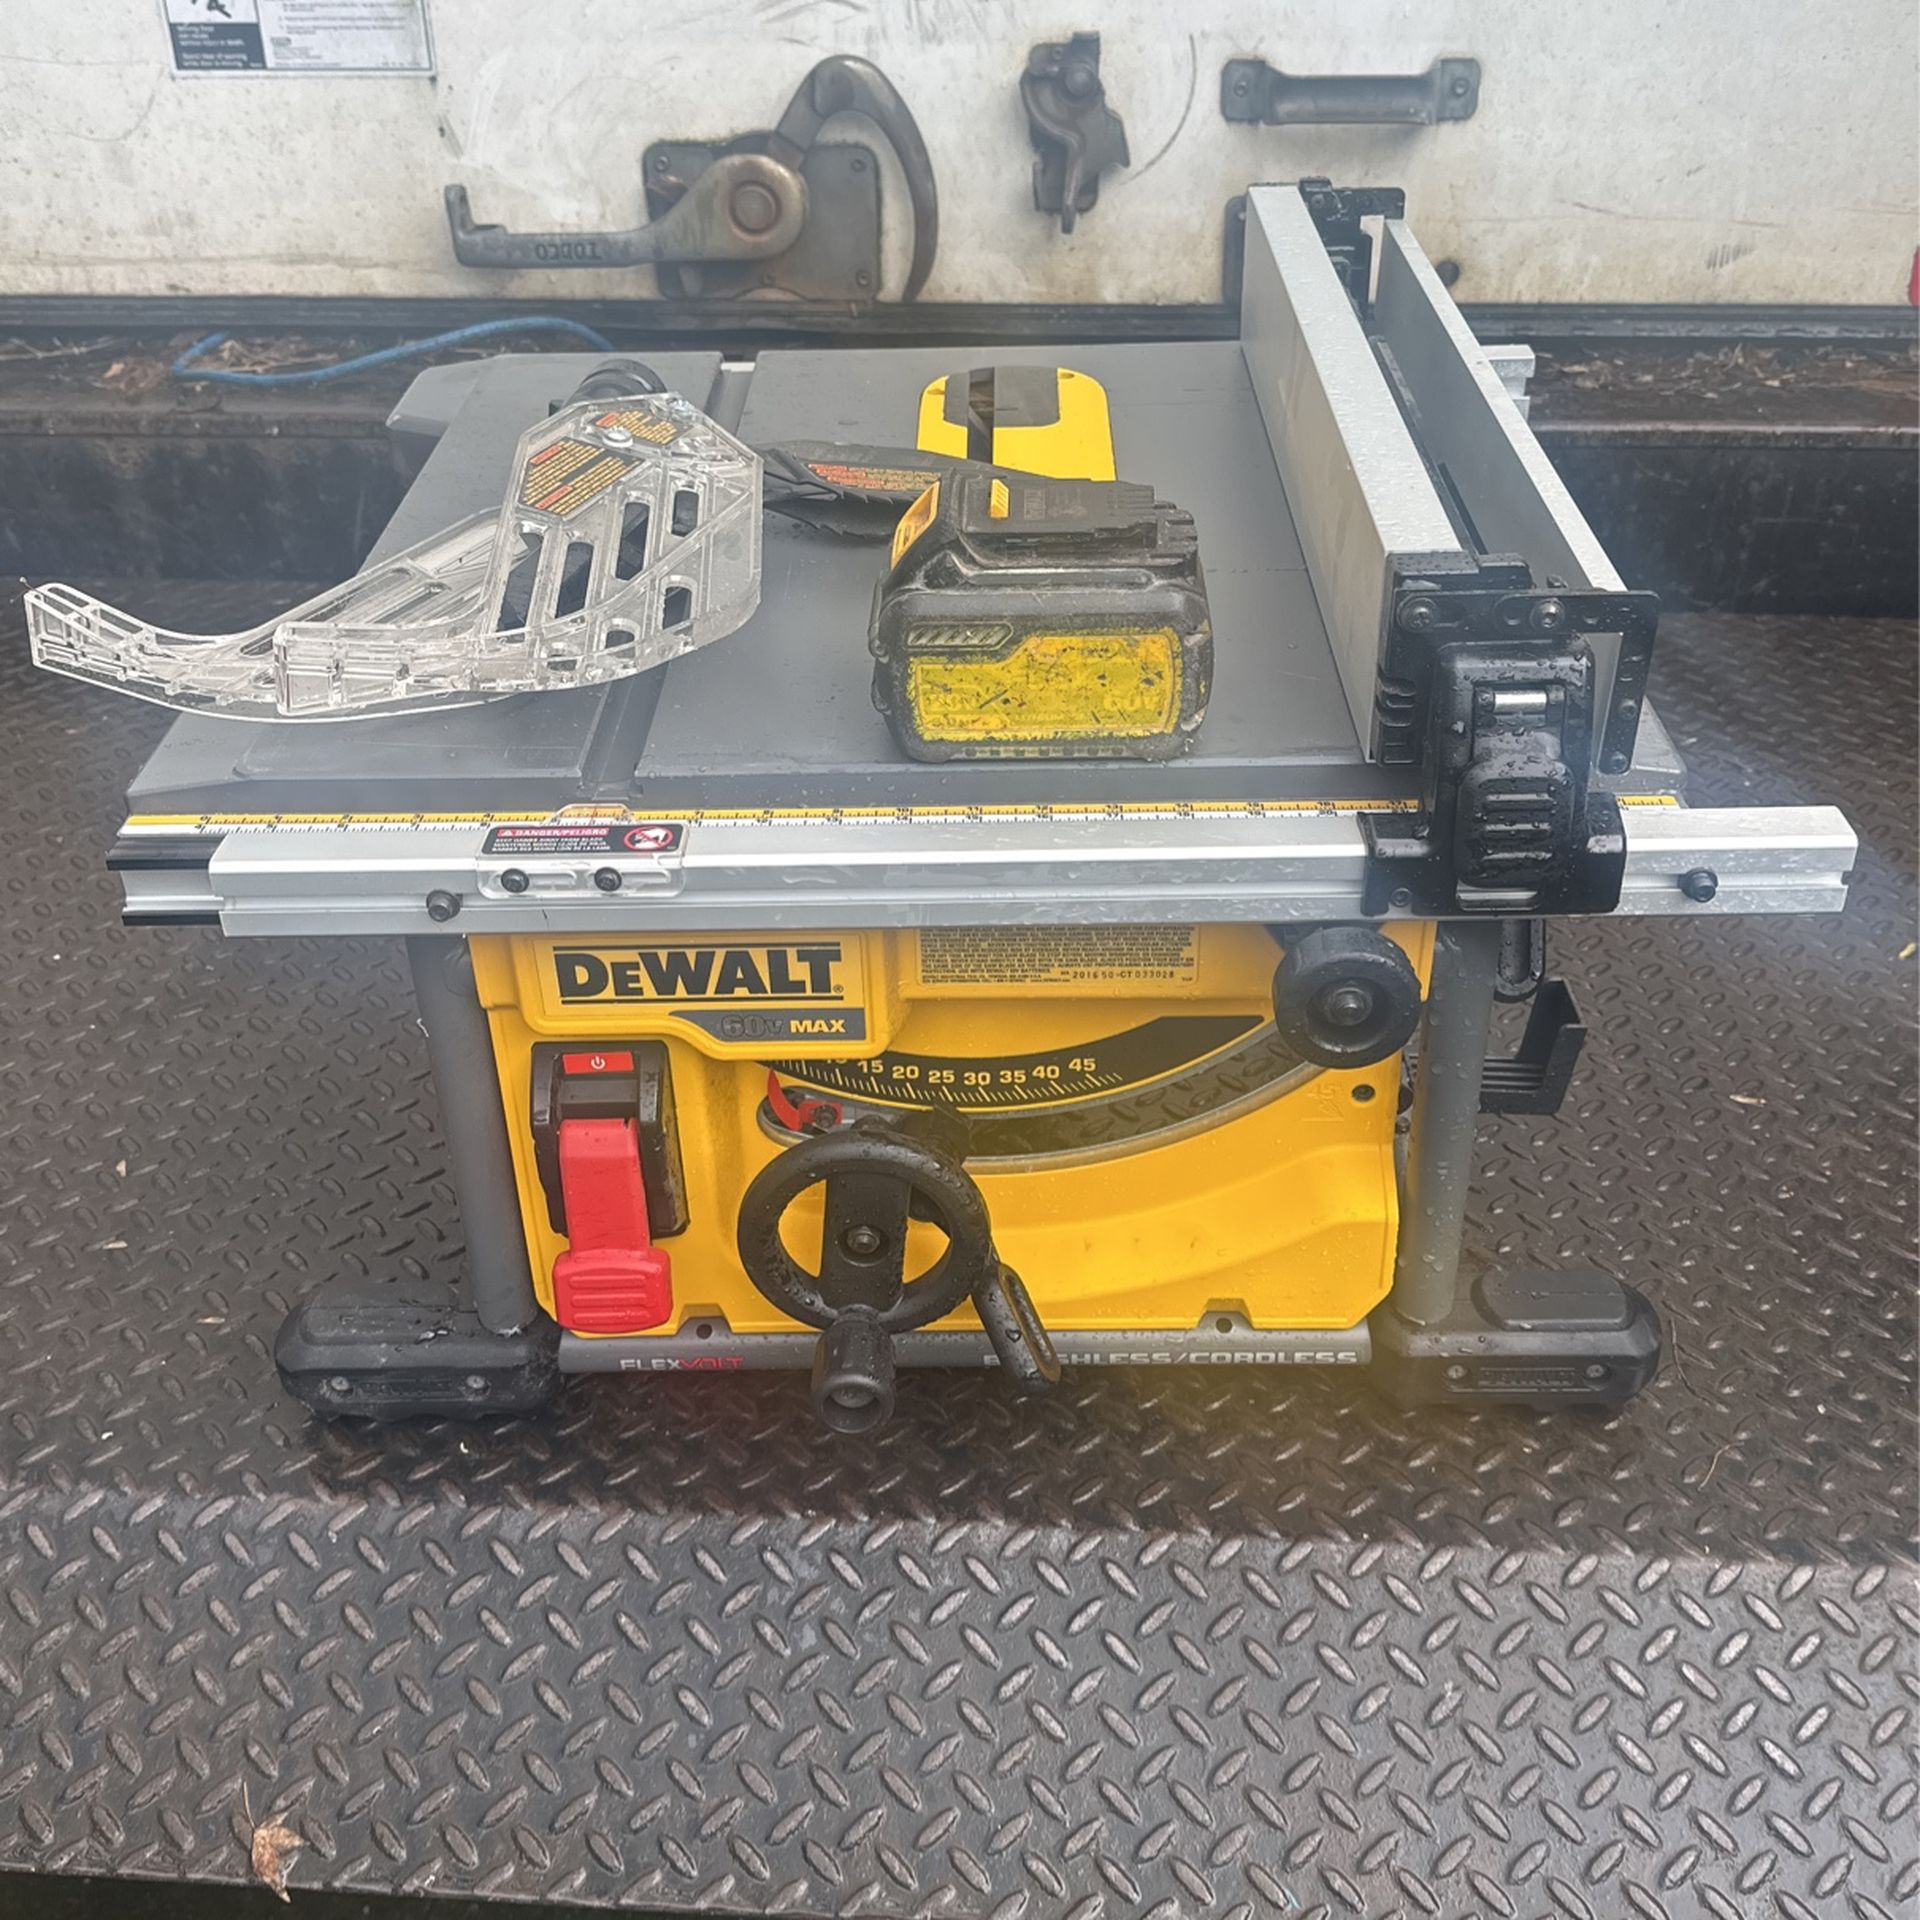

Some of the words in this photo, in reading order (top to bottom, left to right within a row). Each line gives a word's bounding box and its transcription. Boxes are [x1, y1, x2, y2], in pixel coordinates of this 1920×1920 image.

[515, 827, 608, 836] DANGER/PELIGRO
[789, 1019, 847, 1034] MAX
[857, 1059, 884, 1074] 15
[892, 1065, 920, 1080] 20
[928, 1069, 956, 1085] 25
[963, 1071, 991, 1086] 30
[1000, 1070, 1027, 1084] 35
[1032, 1065, 1060, 1080] 40
[1068, 1057, 1097, 1072] 45
[619, 1356, 746, 1372] FLEXVOLT
